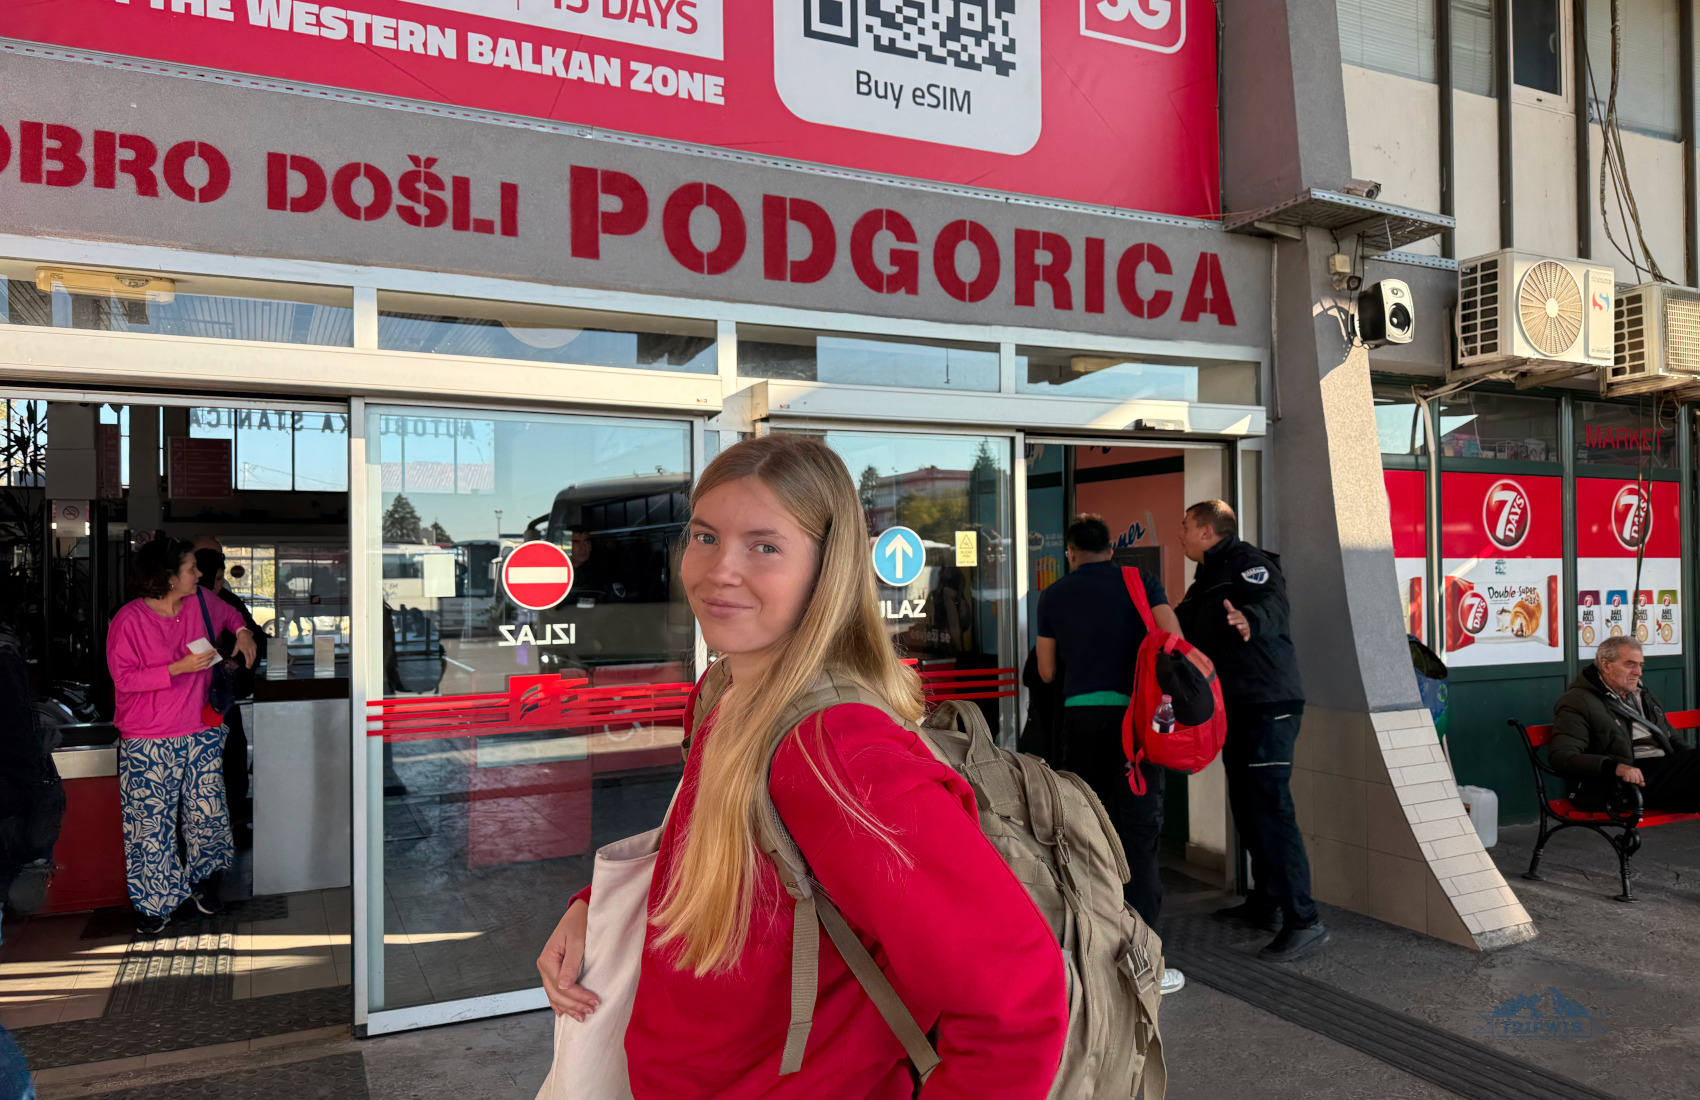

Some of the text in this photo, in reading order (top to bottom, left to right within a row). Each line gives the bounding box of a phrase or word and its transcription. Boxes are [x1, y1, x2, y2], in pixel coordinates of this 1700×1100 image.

[602, 0, 698, 35] DAYS
[246, 0, 457, 60] WESTERN
[467, 32, 621, 88] BALKAN
[630, 61, 725, 105] ZONE
[856, 69, 972, 115] Buy eSIM
[0, 121, 1237, 327] BRO DOŠLI PODGORICA
[1586, 424, 1665, 451] MARKET
[1493, 490, 1518, 540] 7
[1505, 495, 1525, 538] DAYS
[1620, 494, 1640, 540] 7
[1465, 598, 1483, 631] 7
[1473, 599, 1487, 628] DAYS
[1488, 586, 1516, 600] Double
